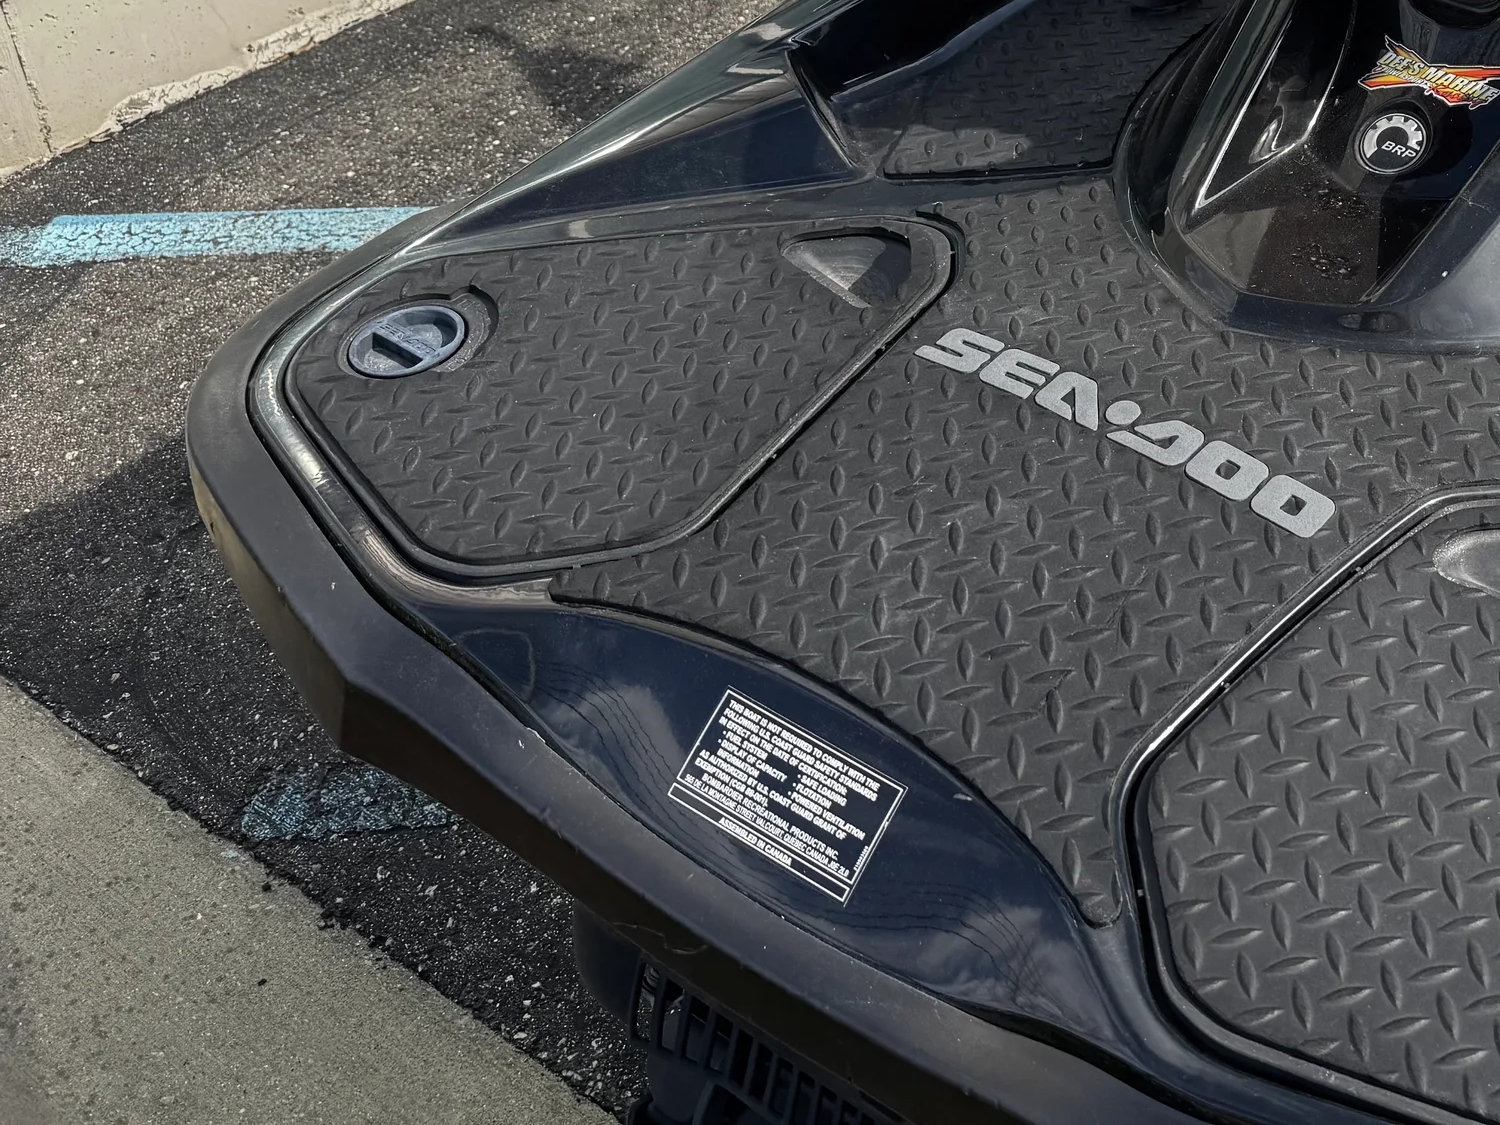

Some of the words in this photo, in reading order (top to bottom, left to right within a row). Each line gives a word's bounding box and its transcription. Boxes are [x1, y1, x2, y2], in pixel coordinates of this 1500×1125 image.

[1377, 49, 1426, 77] DEE'S
[1381, 141, 1417, 159] BRP
[716, 747, 760, 778] INFORMATION
[718, 715, 728, 726] IN
[726, 720, 751, 739] EFFECT
[749, 733, 761, 745] ON
[759, 739, 774, 753] THE
[771, 746, 791, 762] DATE
[788, 756, 800, 767] OF
[797, 762, 848, 796] CERTIFICATION:
[720, 739, 748, 759] DISPLAY
[746, 754, 757, 764] OF
[755, 759, 788, 782] CAPACITY
[723, 707, 760, 734] FOLLOWING
[758, 727, 771, 741] U.S.
[770, 735, 794, 752] COAST
[791, 747, 815, 765] GUARD
[813, 760, 841, 779] SAFETY
[838, 774, 878, 802] STANDARDS
[725, 730, 742, 746] FUEL
[741, 740, 768, 761] SYSTEM
[729, 699, 745, 714] THIS
[742, 707, 762, 723] BOAT
[759, 717, 768, 728] IS
[766, 721, 783, 735] NOT
[780, 729, 813, 753] REQUIRED
[812, 747, 823, 759] TO
[821, 753, 849, 773] COMPLY
[847, 767, 867, 784] WITH
[865, 777, 881, 792] THE
[694, 757, 731, 784] EXEMPTION
[800, 774, 819, 790] SAFE
[816, 784, 847, 807] LOADING
[699, 749, 710, 760] AS
[707, 754, 748, 782] AUTHORIZED
[746, 776, 758, 788] BY
[756, 782, 769, 796] U.S.
[768, 790, 792, 808] COAST
[790, 802, 814, 821] GUARD
[812, 815, 838, 835] GRANT
[835, 829, 847, 840] OF
[701, 772, 744, 803] BOMBARDIER
[741, 797, 790, 832] RECREATIONAL
[789, 825, 827, 852] PRODUCTS
[824, 846, 839, 861] INC.
[790, 791, 823, 815] POWERED
[822, 809, 866, 841] VENTILATION
[795, 783, 832, 809] FLOTATION
[692, 778, 703, 790] DE
[700, 783, 709, 793] LA
[707, 787, 738, 811] MONTAGNE
[735, 804, 757, 821] STREET
[805, 846, 829, 865] CANADA
[717, 816, 758, 844] ASSEMBLED
[756, 839, 766, 851] IN
[764, 844, 792, 866] CANADA
